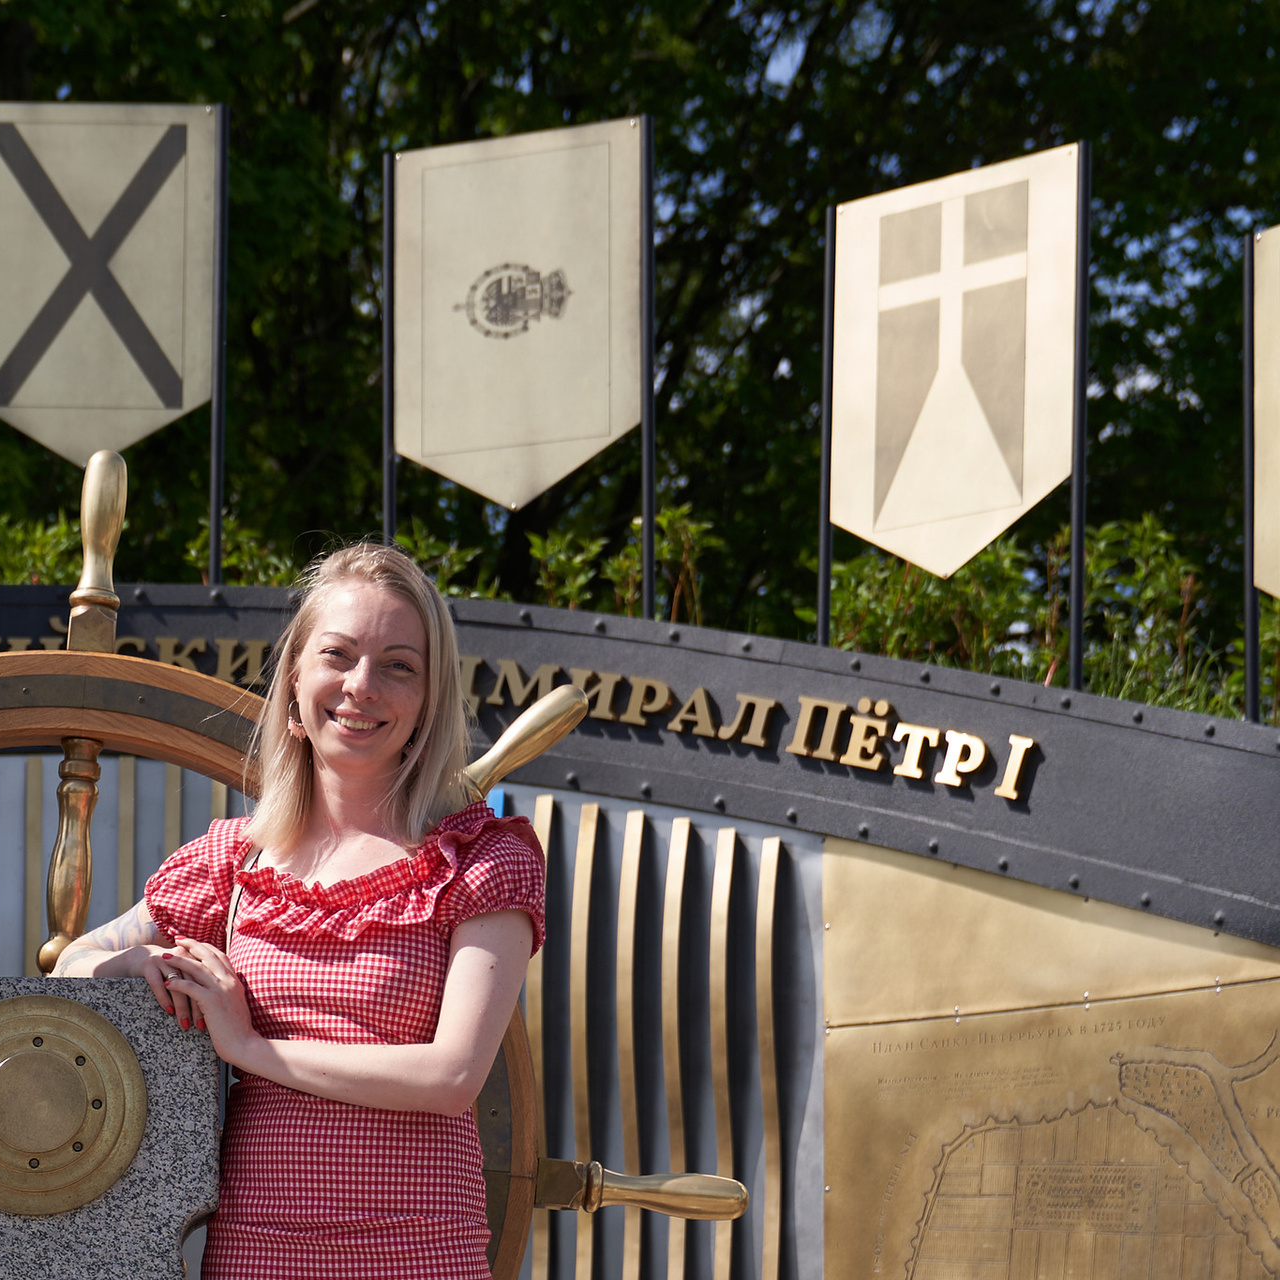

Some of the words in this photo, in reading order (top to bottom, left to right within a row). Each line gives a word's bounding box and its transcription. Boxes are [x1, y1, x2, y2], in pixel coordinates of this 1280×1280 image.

[459, 654, 776, 748] МИРАЛ
[785, 696, 985, 787] ПЁТР
[994, 733, 1034, 800] I
[872, 1041, 914, 1054] ПЛАН
[919, 1025, 1073, 1051] САНКТ-ПЕТЕРБУРГА
[1093, 1020, 1122, 1034] 1725
[1127, 1016, 1167, 1031] ГОДУ
